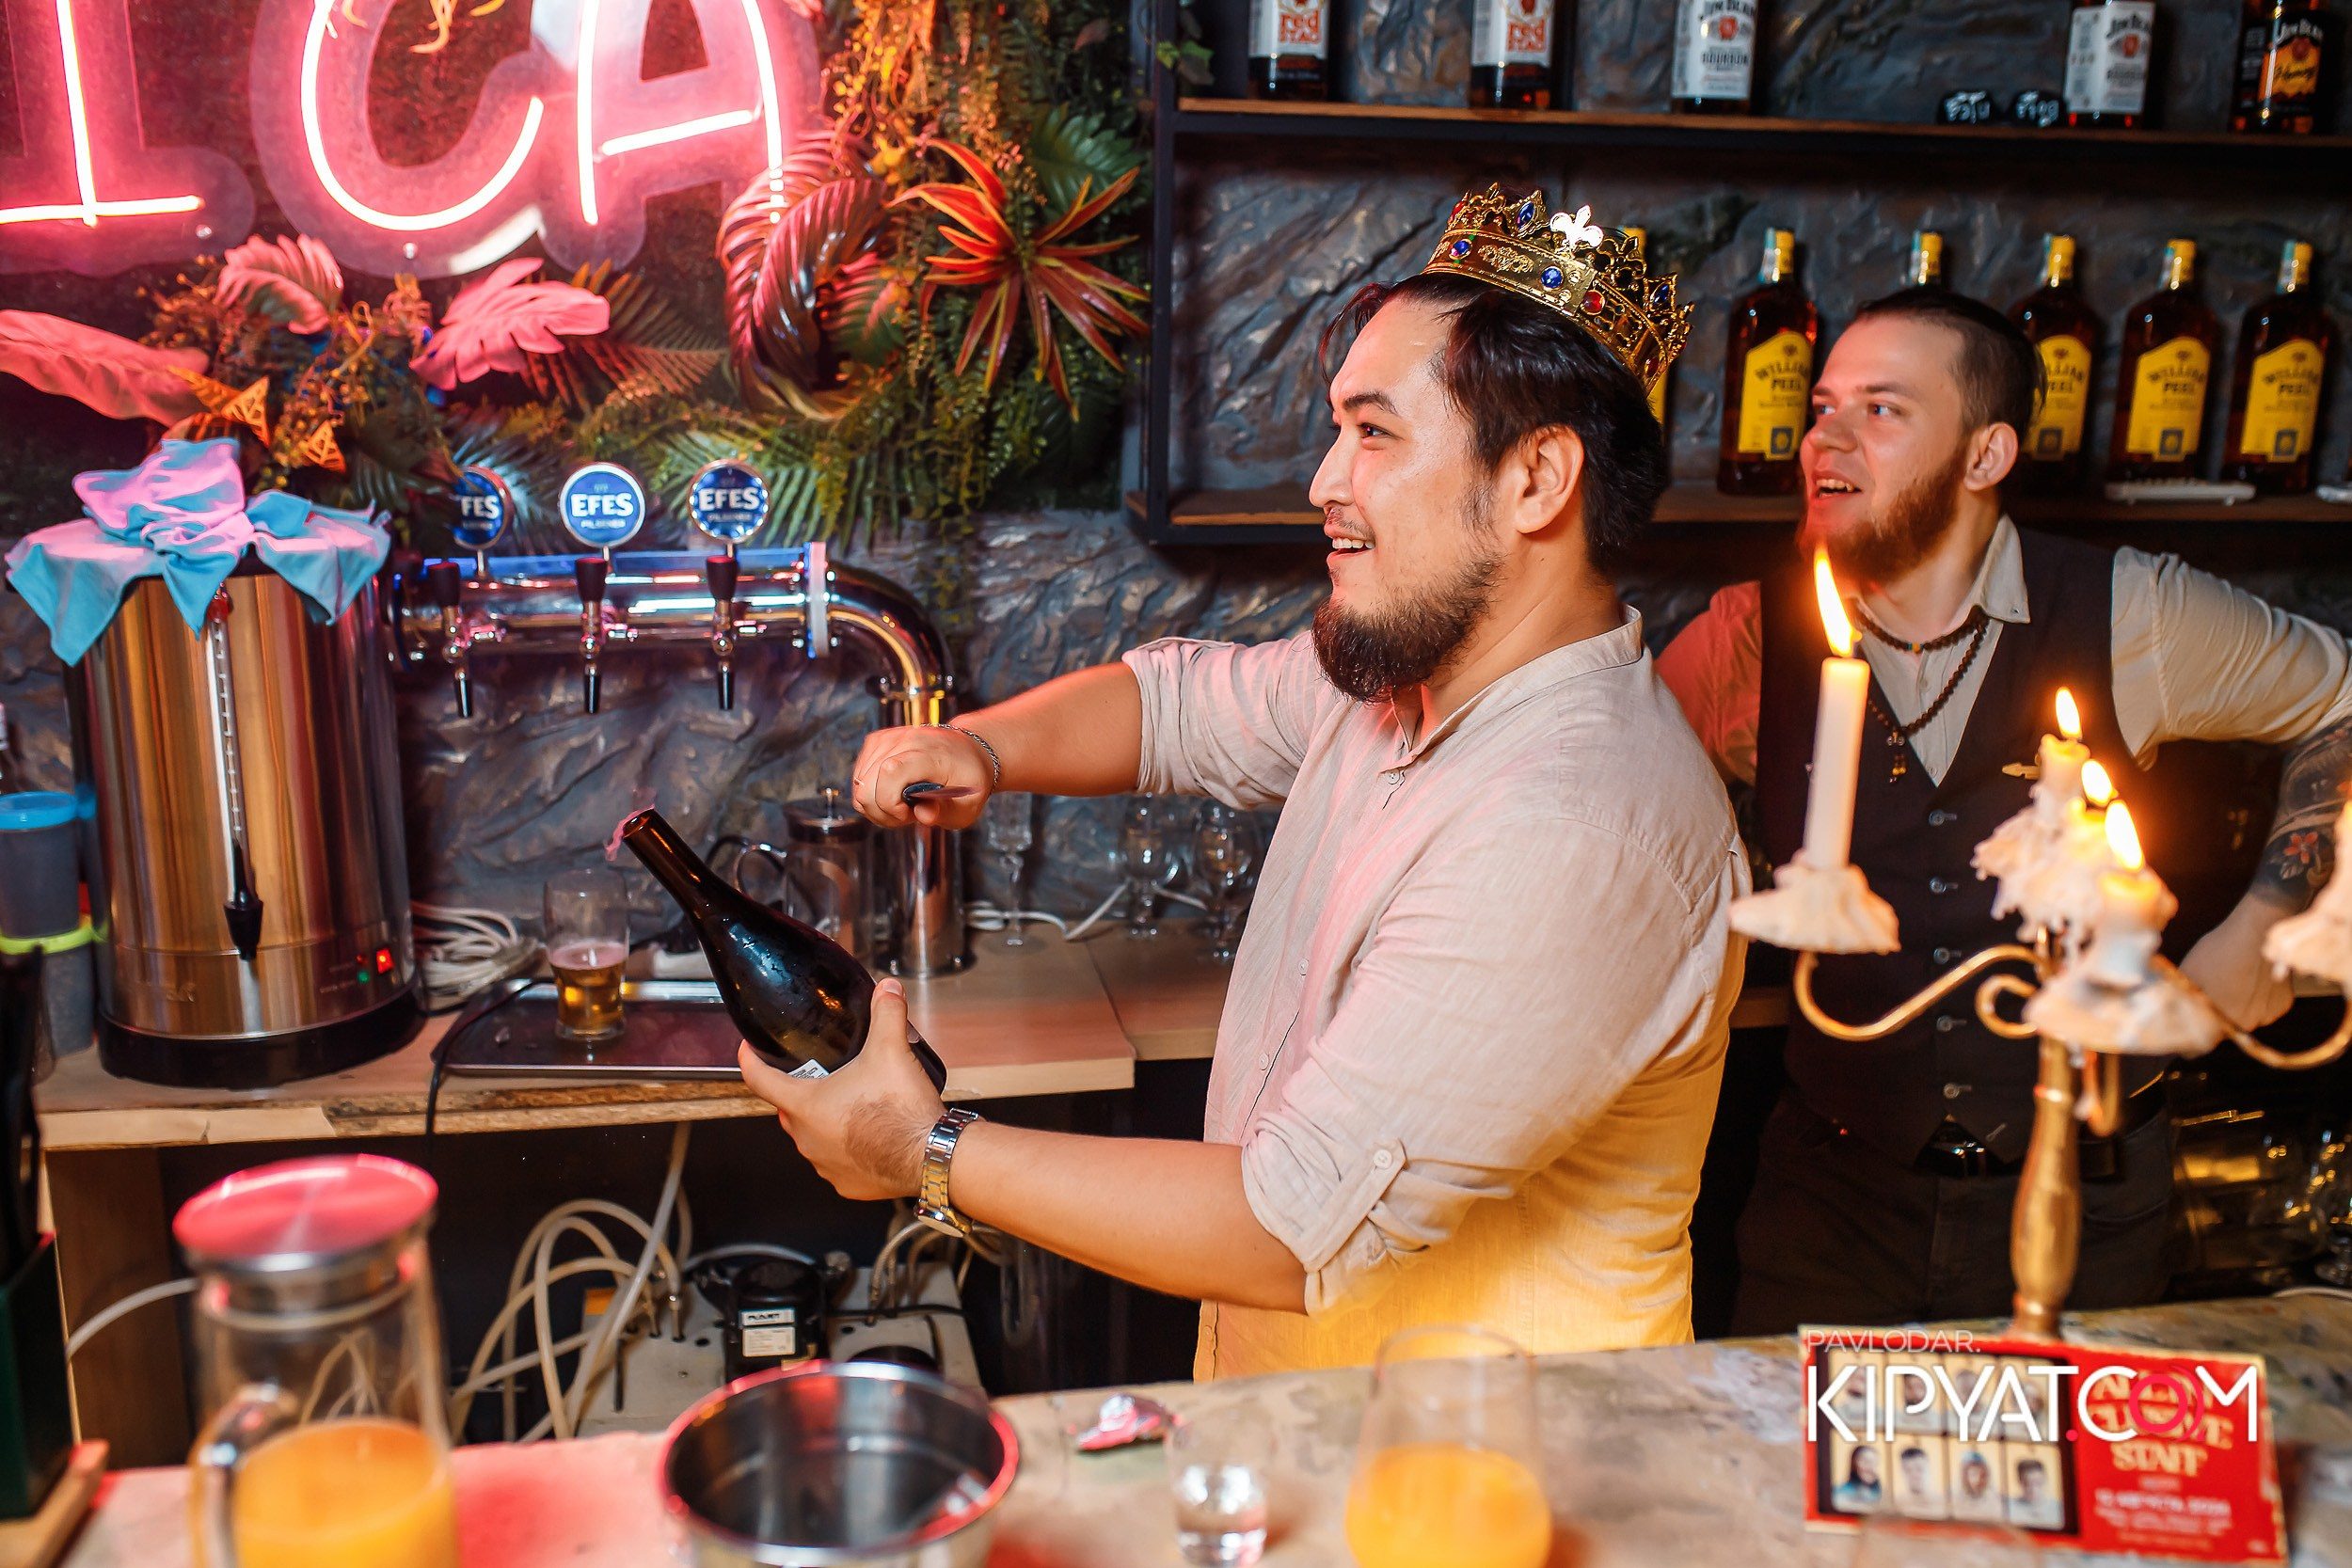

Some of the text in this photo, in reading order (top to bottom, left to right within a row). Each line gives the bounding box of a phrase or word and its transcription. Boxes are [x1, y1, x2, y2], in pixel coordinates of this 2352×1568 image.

[1279, 9, 1319, 31] red
[1507, 19, 1546, 40] red
[460, 494, 501, 519] FES
[570, 491, 635, 518] EFES
[698, 487, 760, 511] EFES
